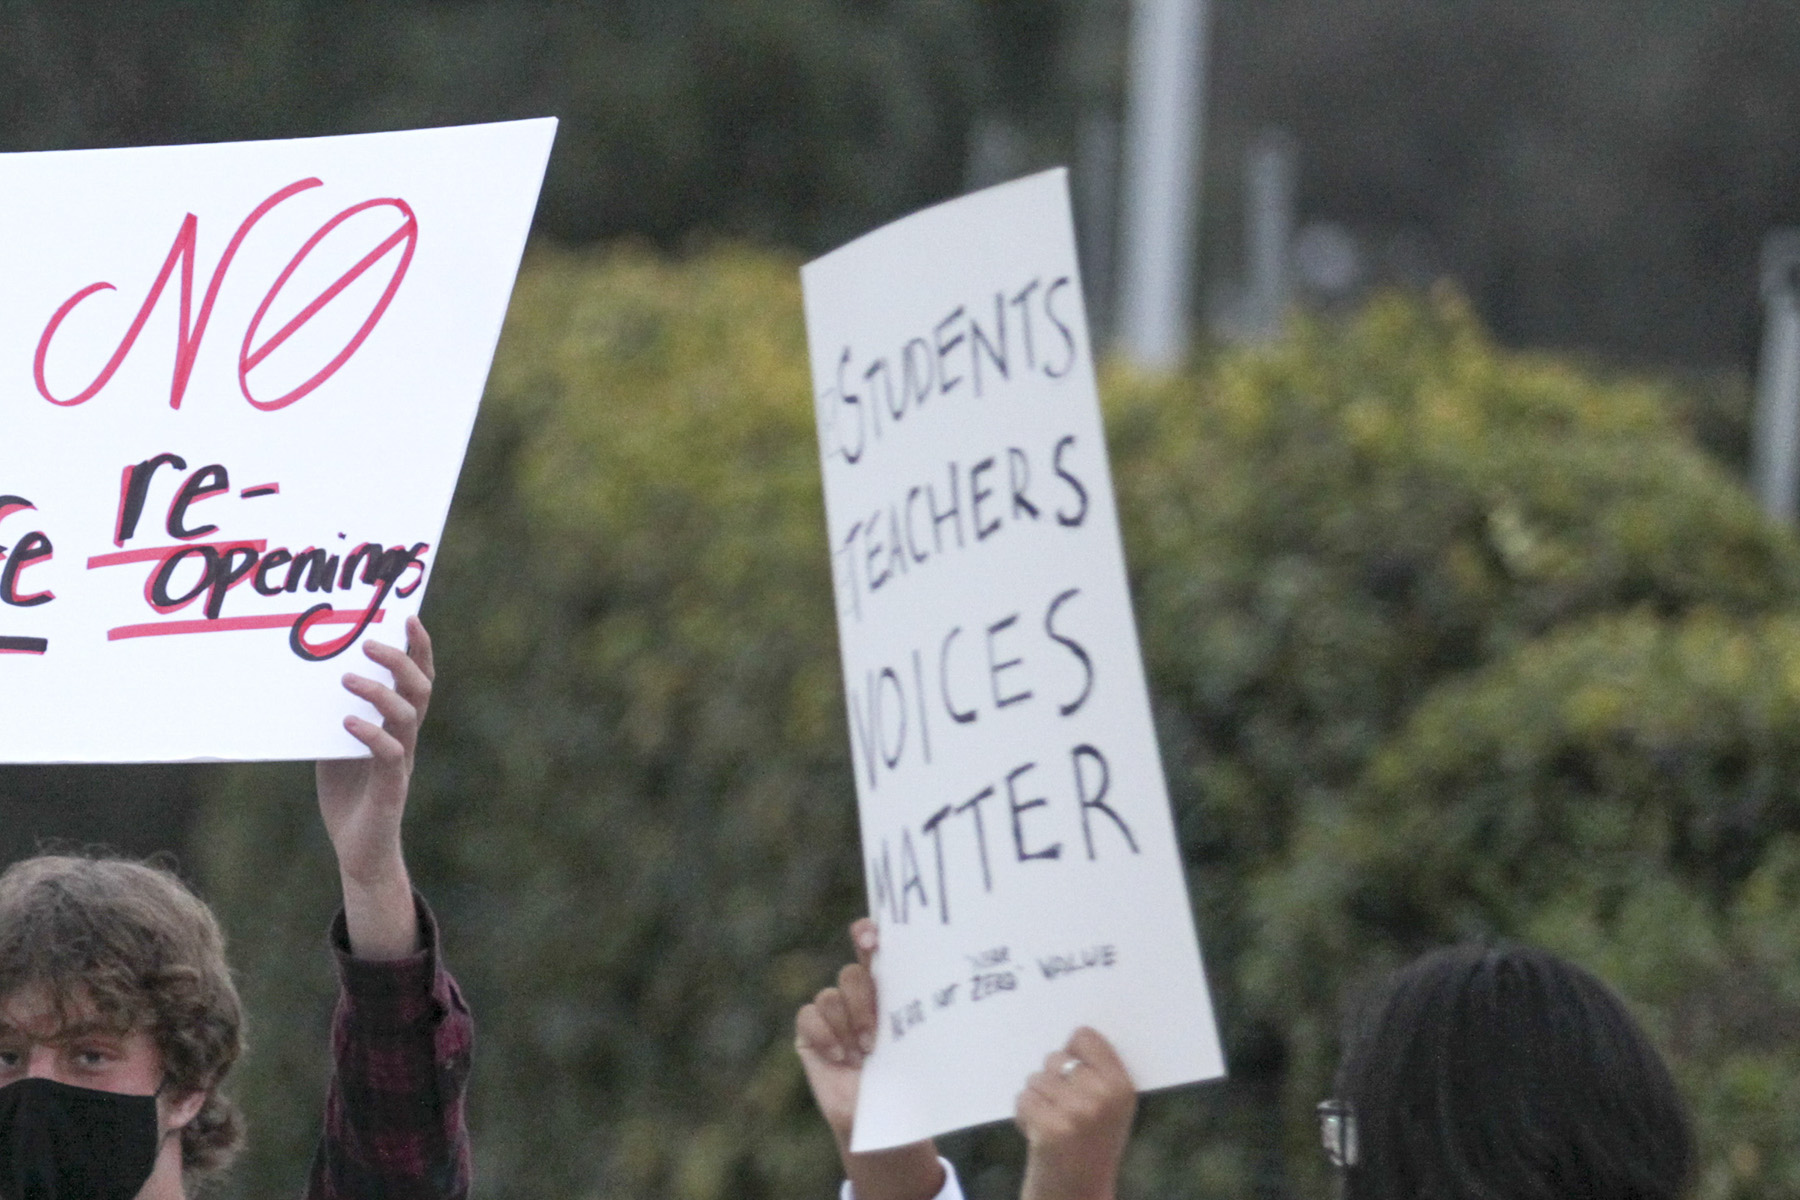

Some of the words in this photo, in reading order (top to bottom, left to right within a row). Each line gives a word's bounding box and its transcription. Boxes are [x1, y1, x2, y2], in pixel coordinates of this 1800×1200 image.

[34, 177, 417, 411] NO
[833, 275, 1075, 465] STUDENTS
[143, 524, 430, 662] openings
[838, 435, 1088, 620] TEACHERS
[851, 587, 1094, 792] VOICES
[872, 743, 1140, 926] MATTER
